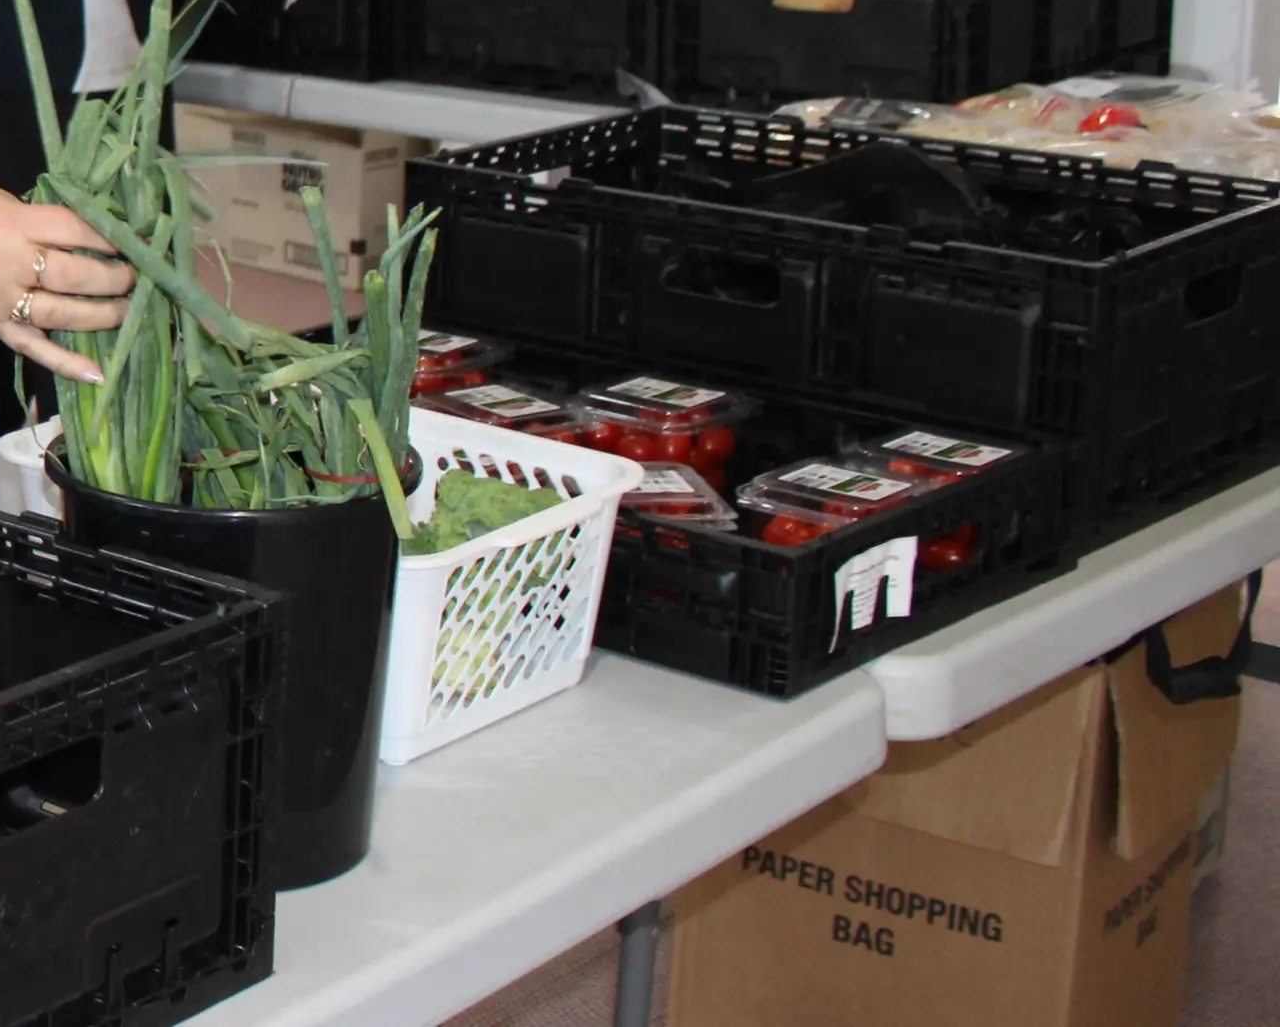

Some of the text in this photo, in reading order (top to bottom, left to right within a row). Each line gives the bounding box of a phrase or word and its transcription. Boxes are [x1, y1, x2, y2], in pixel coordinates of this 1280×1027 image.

[742, 845, 1004, 943] PAPER SHOPPING
[833, 914, 895, 957] BAG
